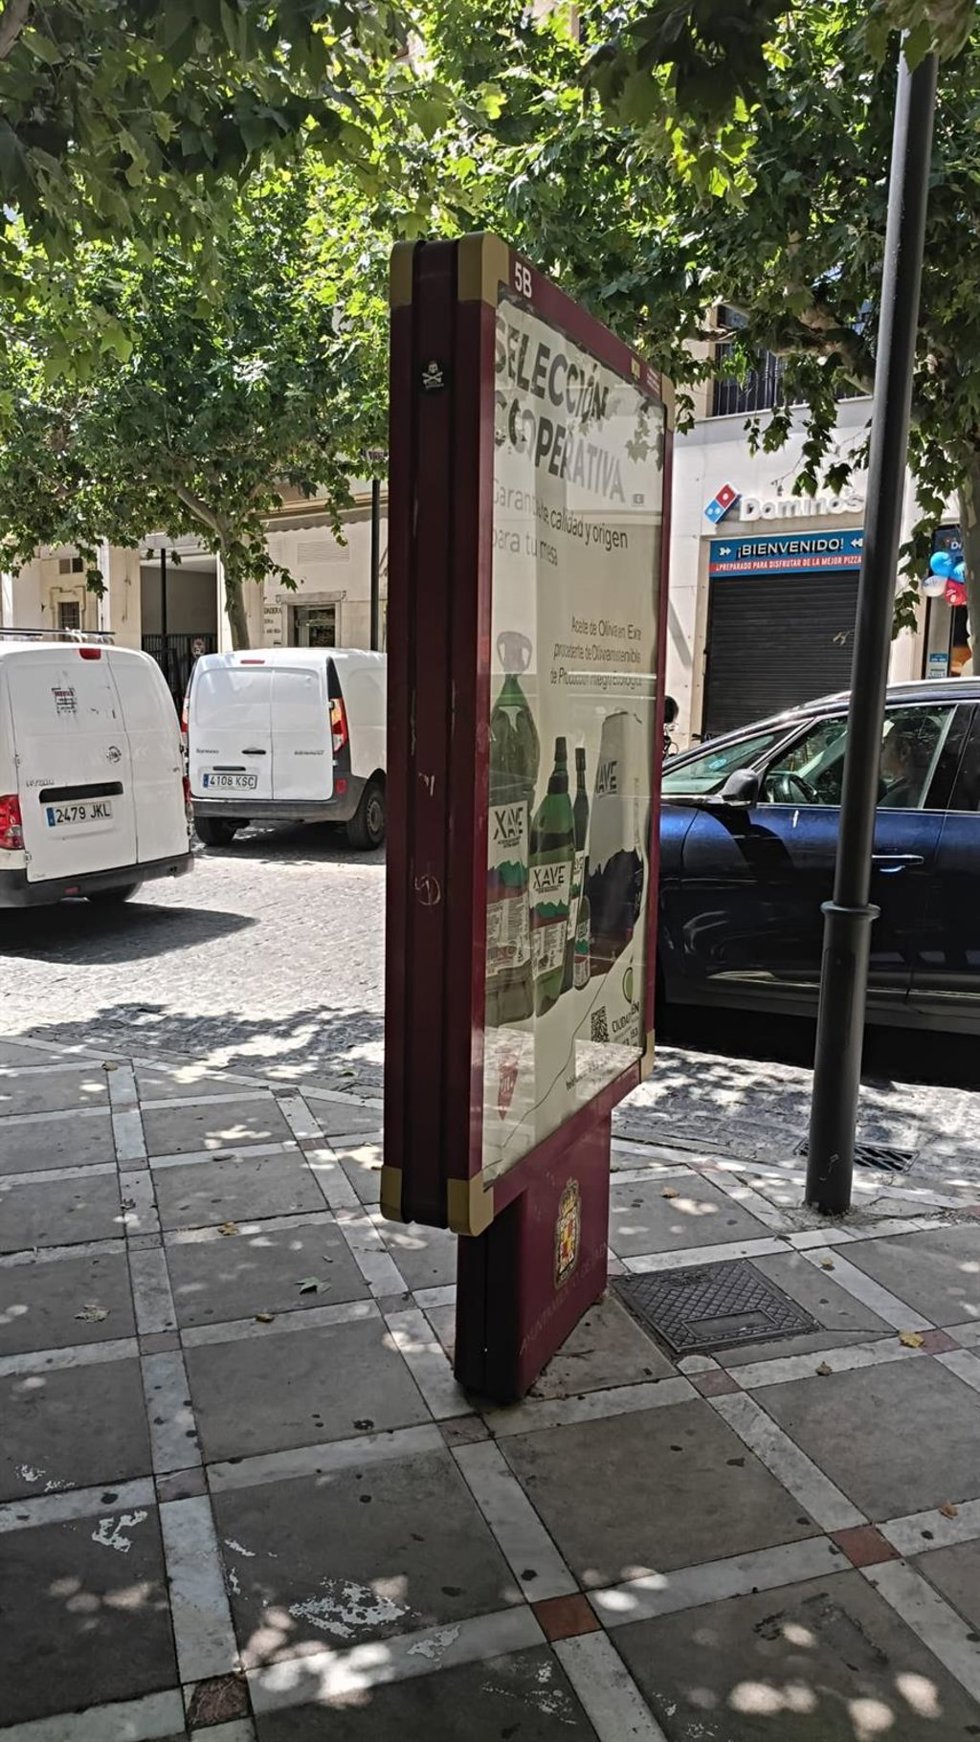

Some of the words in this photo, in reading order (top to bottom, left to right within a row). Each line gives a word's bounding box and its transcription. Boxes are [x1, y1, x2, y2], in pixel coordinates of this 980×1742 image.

[514, 261, 532, 299] 5B
[495, 314, 609, 424] SELECCIÓN
[550, 505, 584, 540] calidad
[585, 524, 593, 546] y
[592, 523, 629, 552] origen
[737, 538, 845, 559] ¡BIENVENIDO!
[752, 559, 768, 570] PARA
[768, 557, 801, 569] DISFRUTAR
[802, 557, 811, 567] DE
[811, 556, 820, 566] LA
[821, 555, 842, 566] MEJOR
[842, 554, 862, 564] PIZZA
[210, 776, 233, 787] 4108
[235, 775, 255, 788] KSC
[55, 806, 87, 824] 2479
[90, 803, 112, 819] JKL
[533, 865, 567, 889] XAVE
